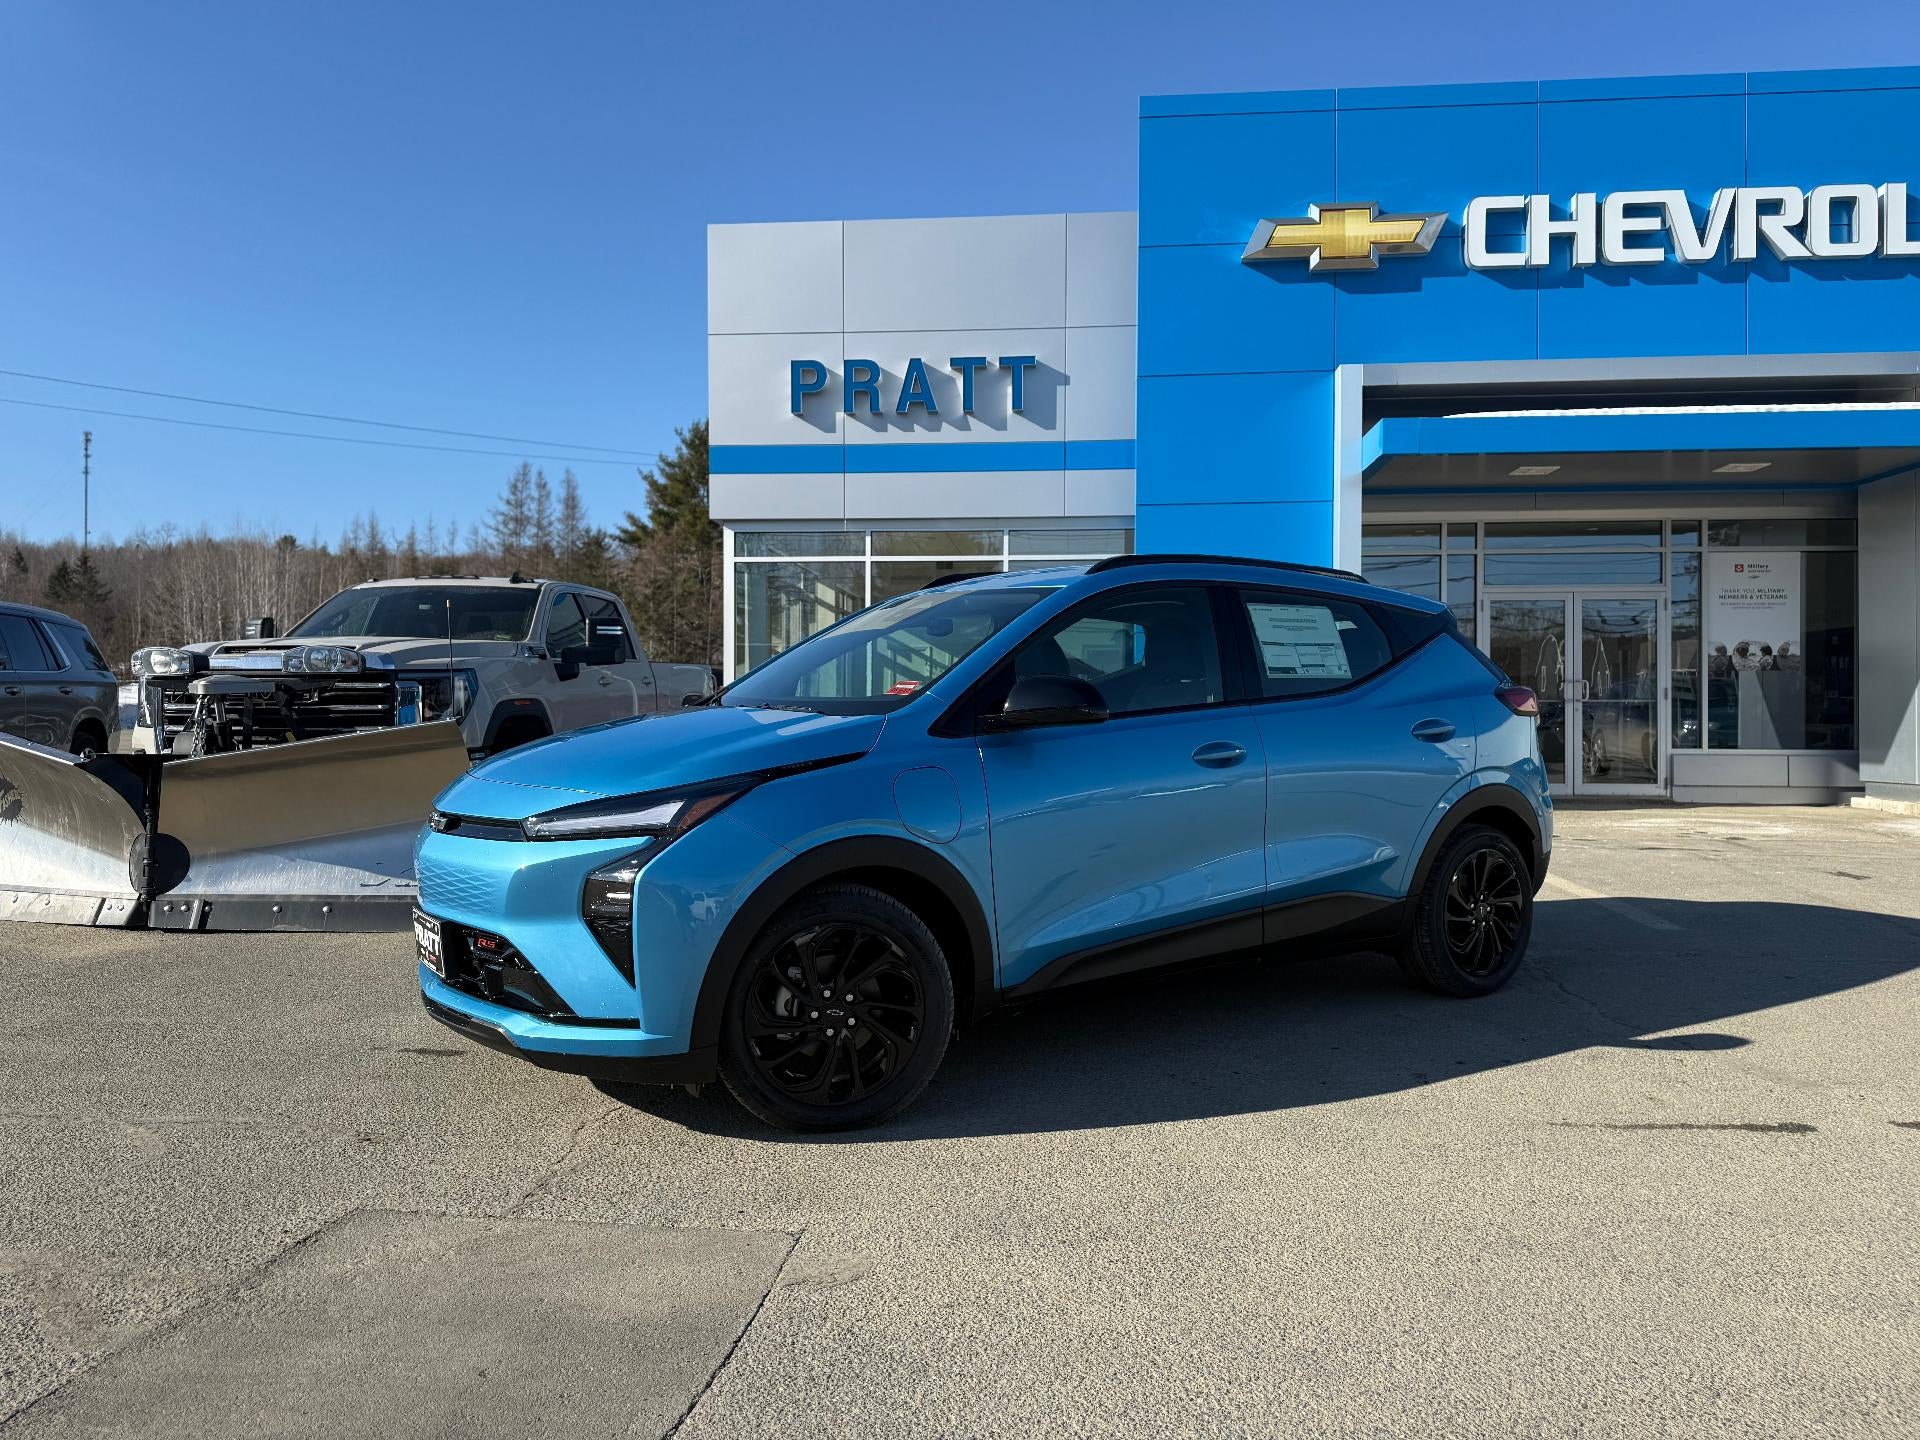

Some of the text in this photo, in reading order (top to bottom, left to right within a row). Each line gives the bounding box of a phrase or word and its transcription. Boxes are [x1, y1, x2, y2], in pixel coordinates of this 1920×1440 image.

[790, 356, 1037, 416] PRATT
[414, 920, 439, 955] PRATT
[477, 937, 496, 949] RS
